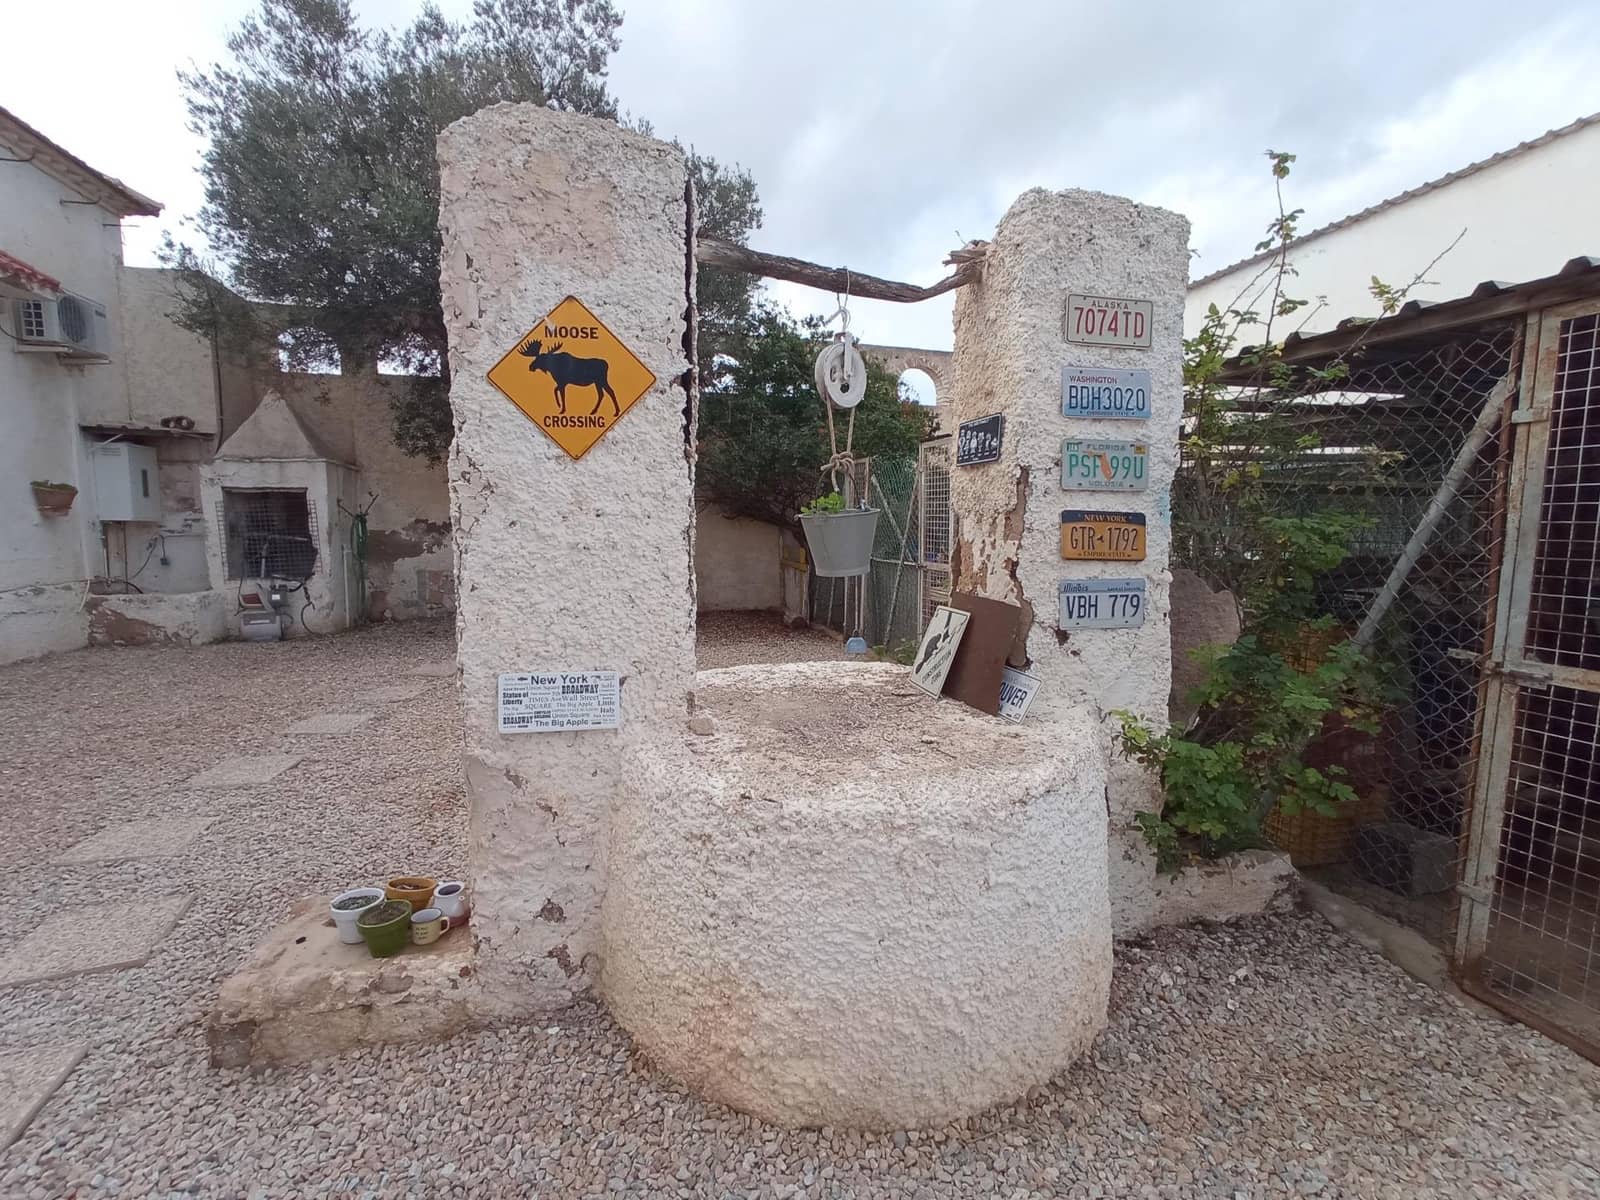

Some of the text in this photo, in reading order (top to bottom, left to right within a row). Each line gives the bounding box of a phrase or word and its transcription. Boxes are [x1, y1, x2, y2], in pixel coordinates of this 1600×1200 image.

[1091, 300, 1129, 310] ALASKA
[1074, 307, 1145, 339] 7074TD
[544, 325, 599, 340] MOOSE
[1069, 375, 1118, 385] WASHINGTON
[1068, 385, 1146, 411] BDH3020
[543, 415, 606, 429] CROSSING
[1086, 443, 1127, 451] FLORIDA
[1110, 455, 1144, 480] 99U
[1083, 513, 1127, 523] NEW YORK
[1070, 526, 1139, 552] GTR 1792
[1064, 582, 1089, 592] Illinois
[1066, 594, 1140, 619] VBH 779
[530, 675, 557, 685] New
[560, 674, 588, 684] York
[561, 684, 599, 694] BROADWAY
[535, 719, 550, 727] The
[551, 719, 565, 728] Big
[565, 718, 589, 727] Apple
